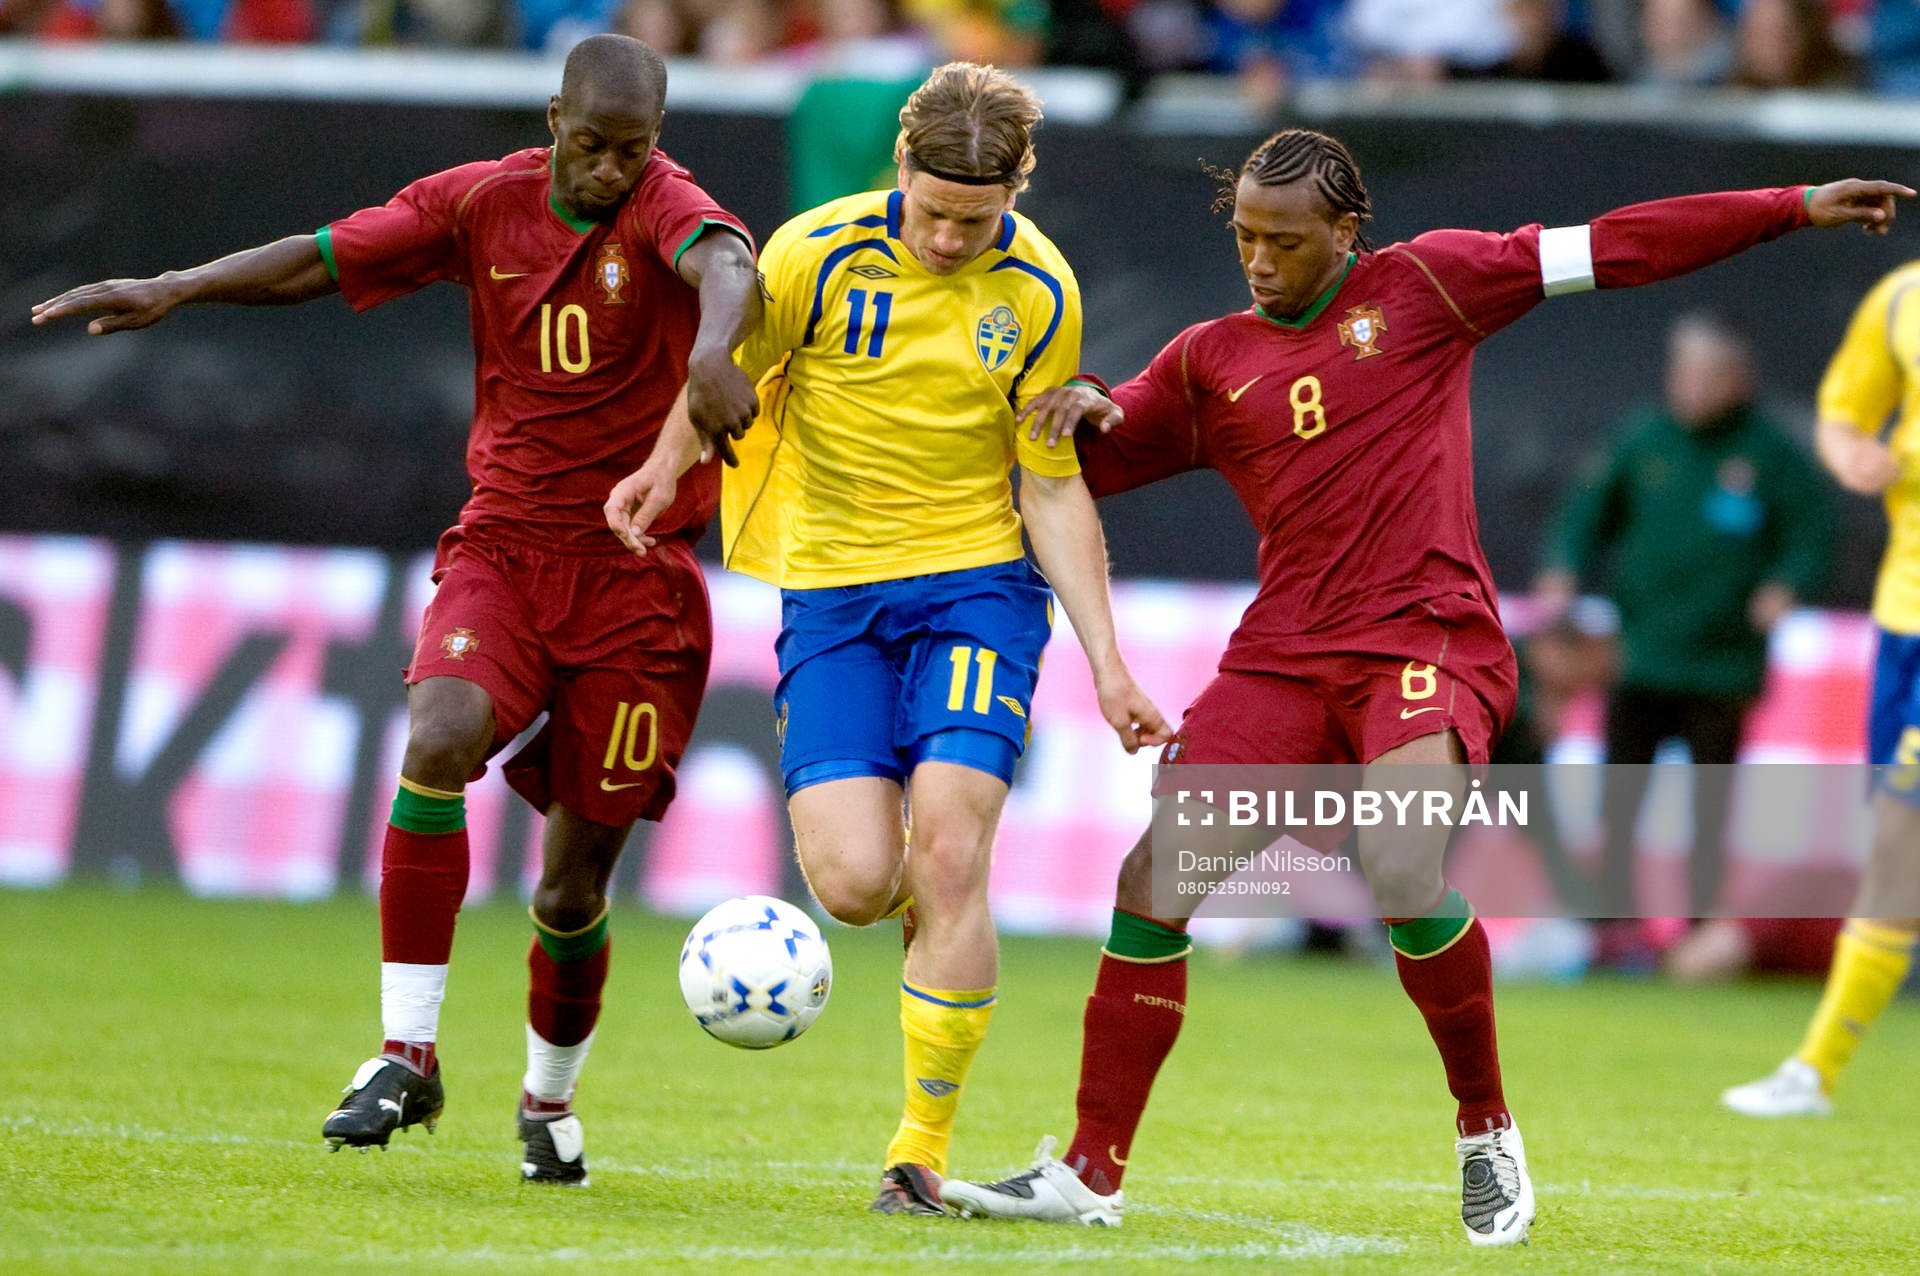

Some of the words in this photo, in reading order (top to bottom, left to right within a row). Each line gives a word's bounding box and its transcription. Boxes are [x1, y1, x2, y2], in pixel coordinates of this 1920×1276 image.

[540, 303, 591, 374] 10
[844, 288, 893, 358] 11
[1289, 375, 1327, 440] 8
[947, 646, 998, 715] 11
[1401, 660, 1437, 700] 8
[603, 701, 658, 771] 10
